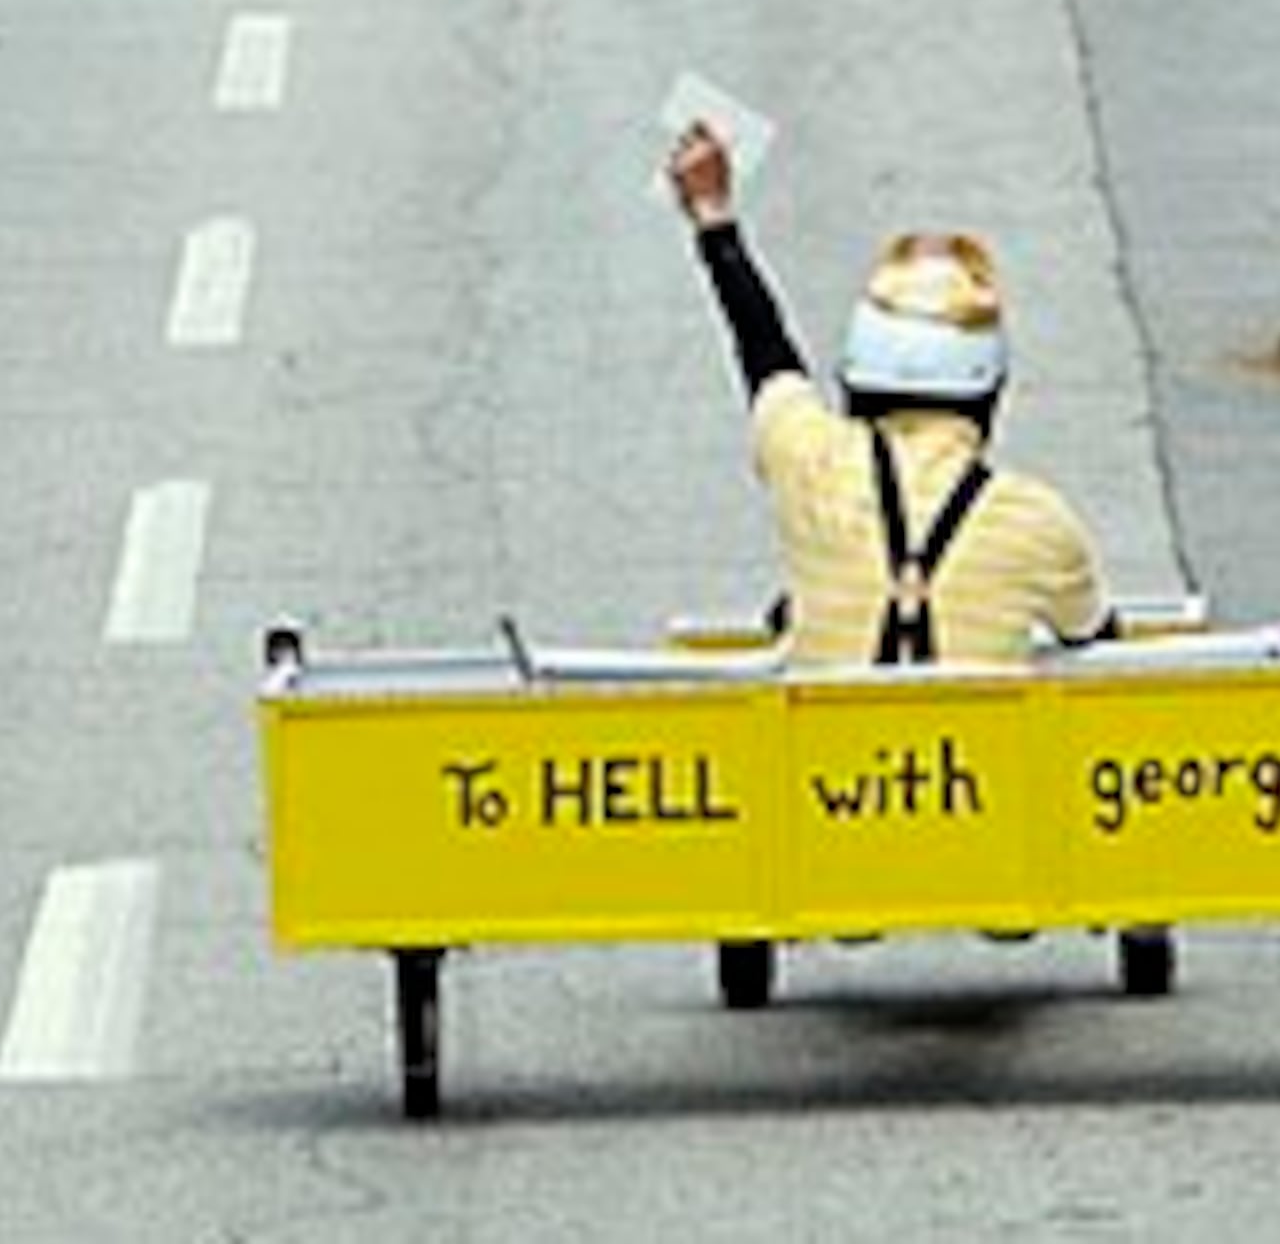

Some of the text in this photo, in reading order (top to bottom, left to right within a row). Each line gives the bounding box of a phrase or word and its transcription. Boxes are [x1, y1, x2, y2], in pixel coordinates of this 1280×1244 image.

[441, 757, 509, 828] To
[540, 755, 740, 826] HELL
[810, 737, 982, 818] with
